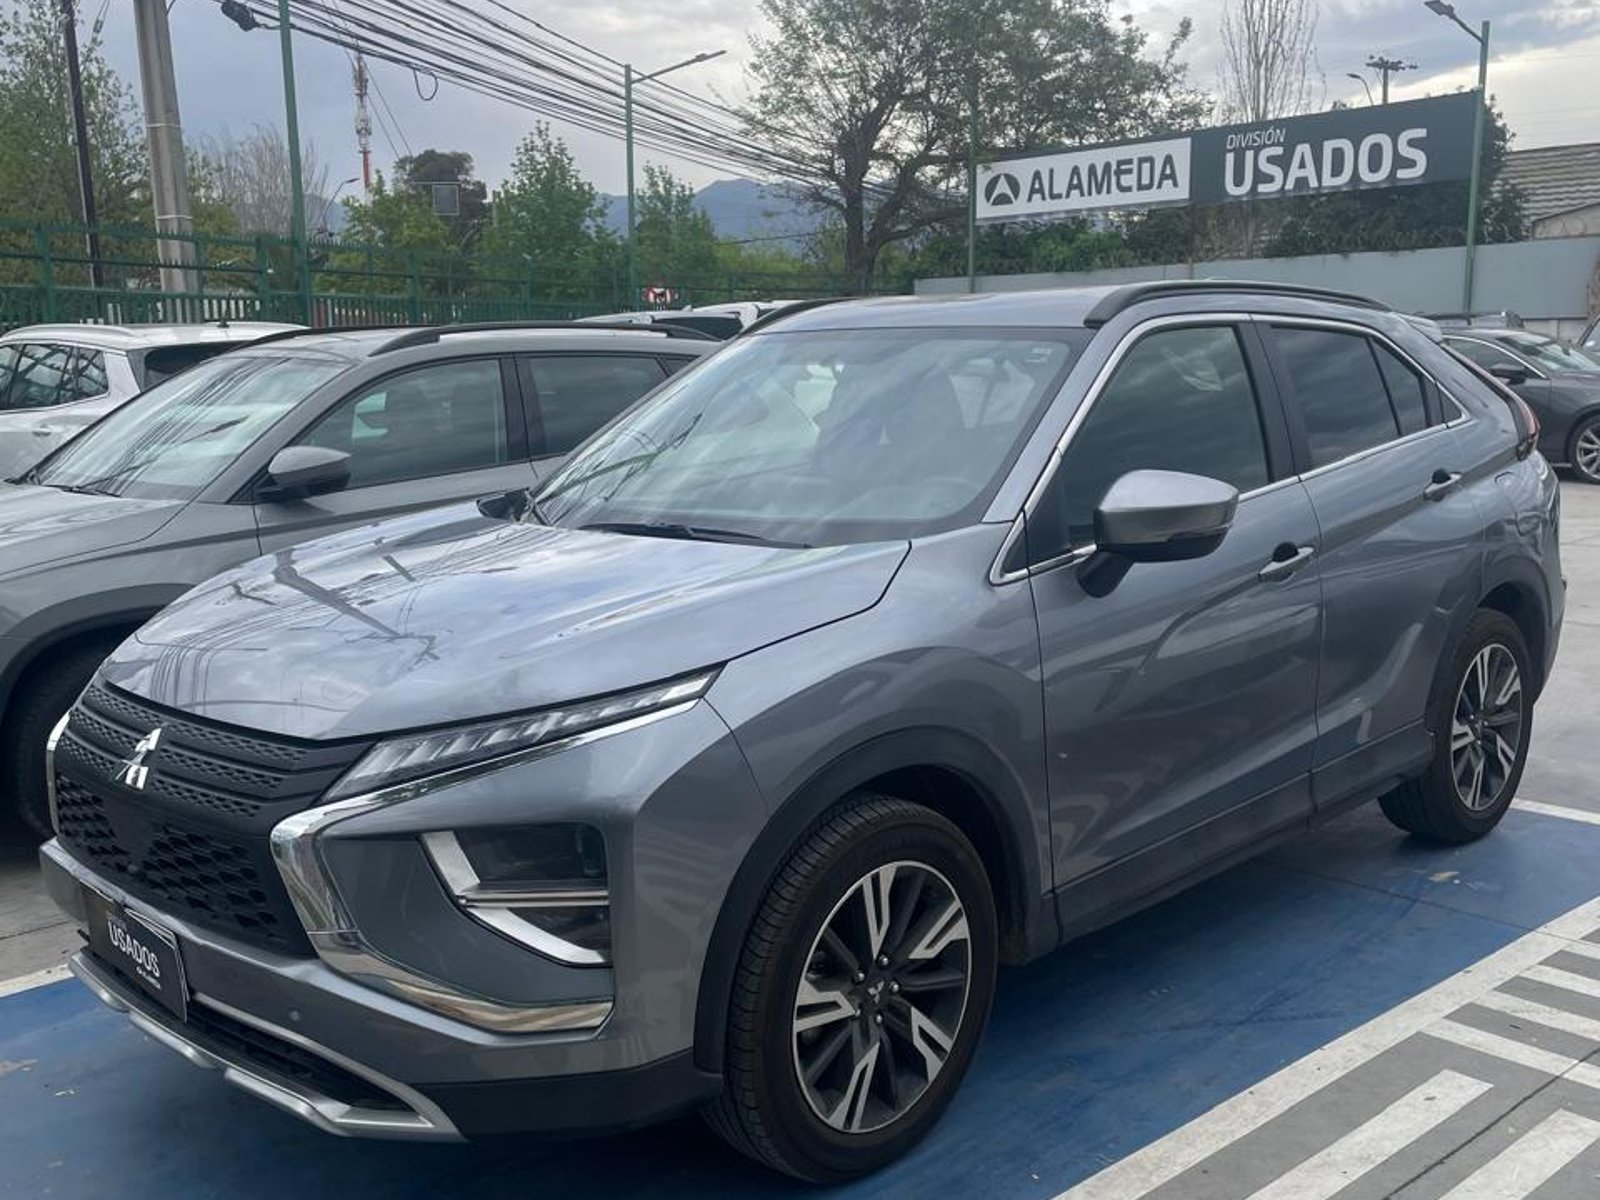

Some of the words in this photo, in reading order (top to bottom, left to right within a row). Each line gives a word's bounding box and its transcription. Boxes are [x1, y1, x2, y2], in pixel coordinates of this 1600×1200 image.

[1225, 128, 1428, 197] USADOS
[1227, 126, 1285, 150] DIVISIÓN
[1027, 154, 1178, 202] ALAMEDA
[107, 920, 161, 978] USADOS
